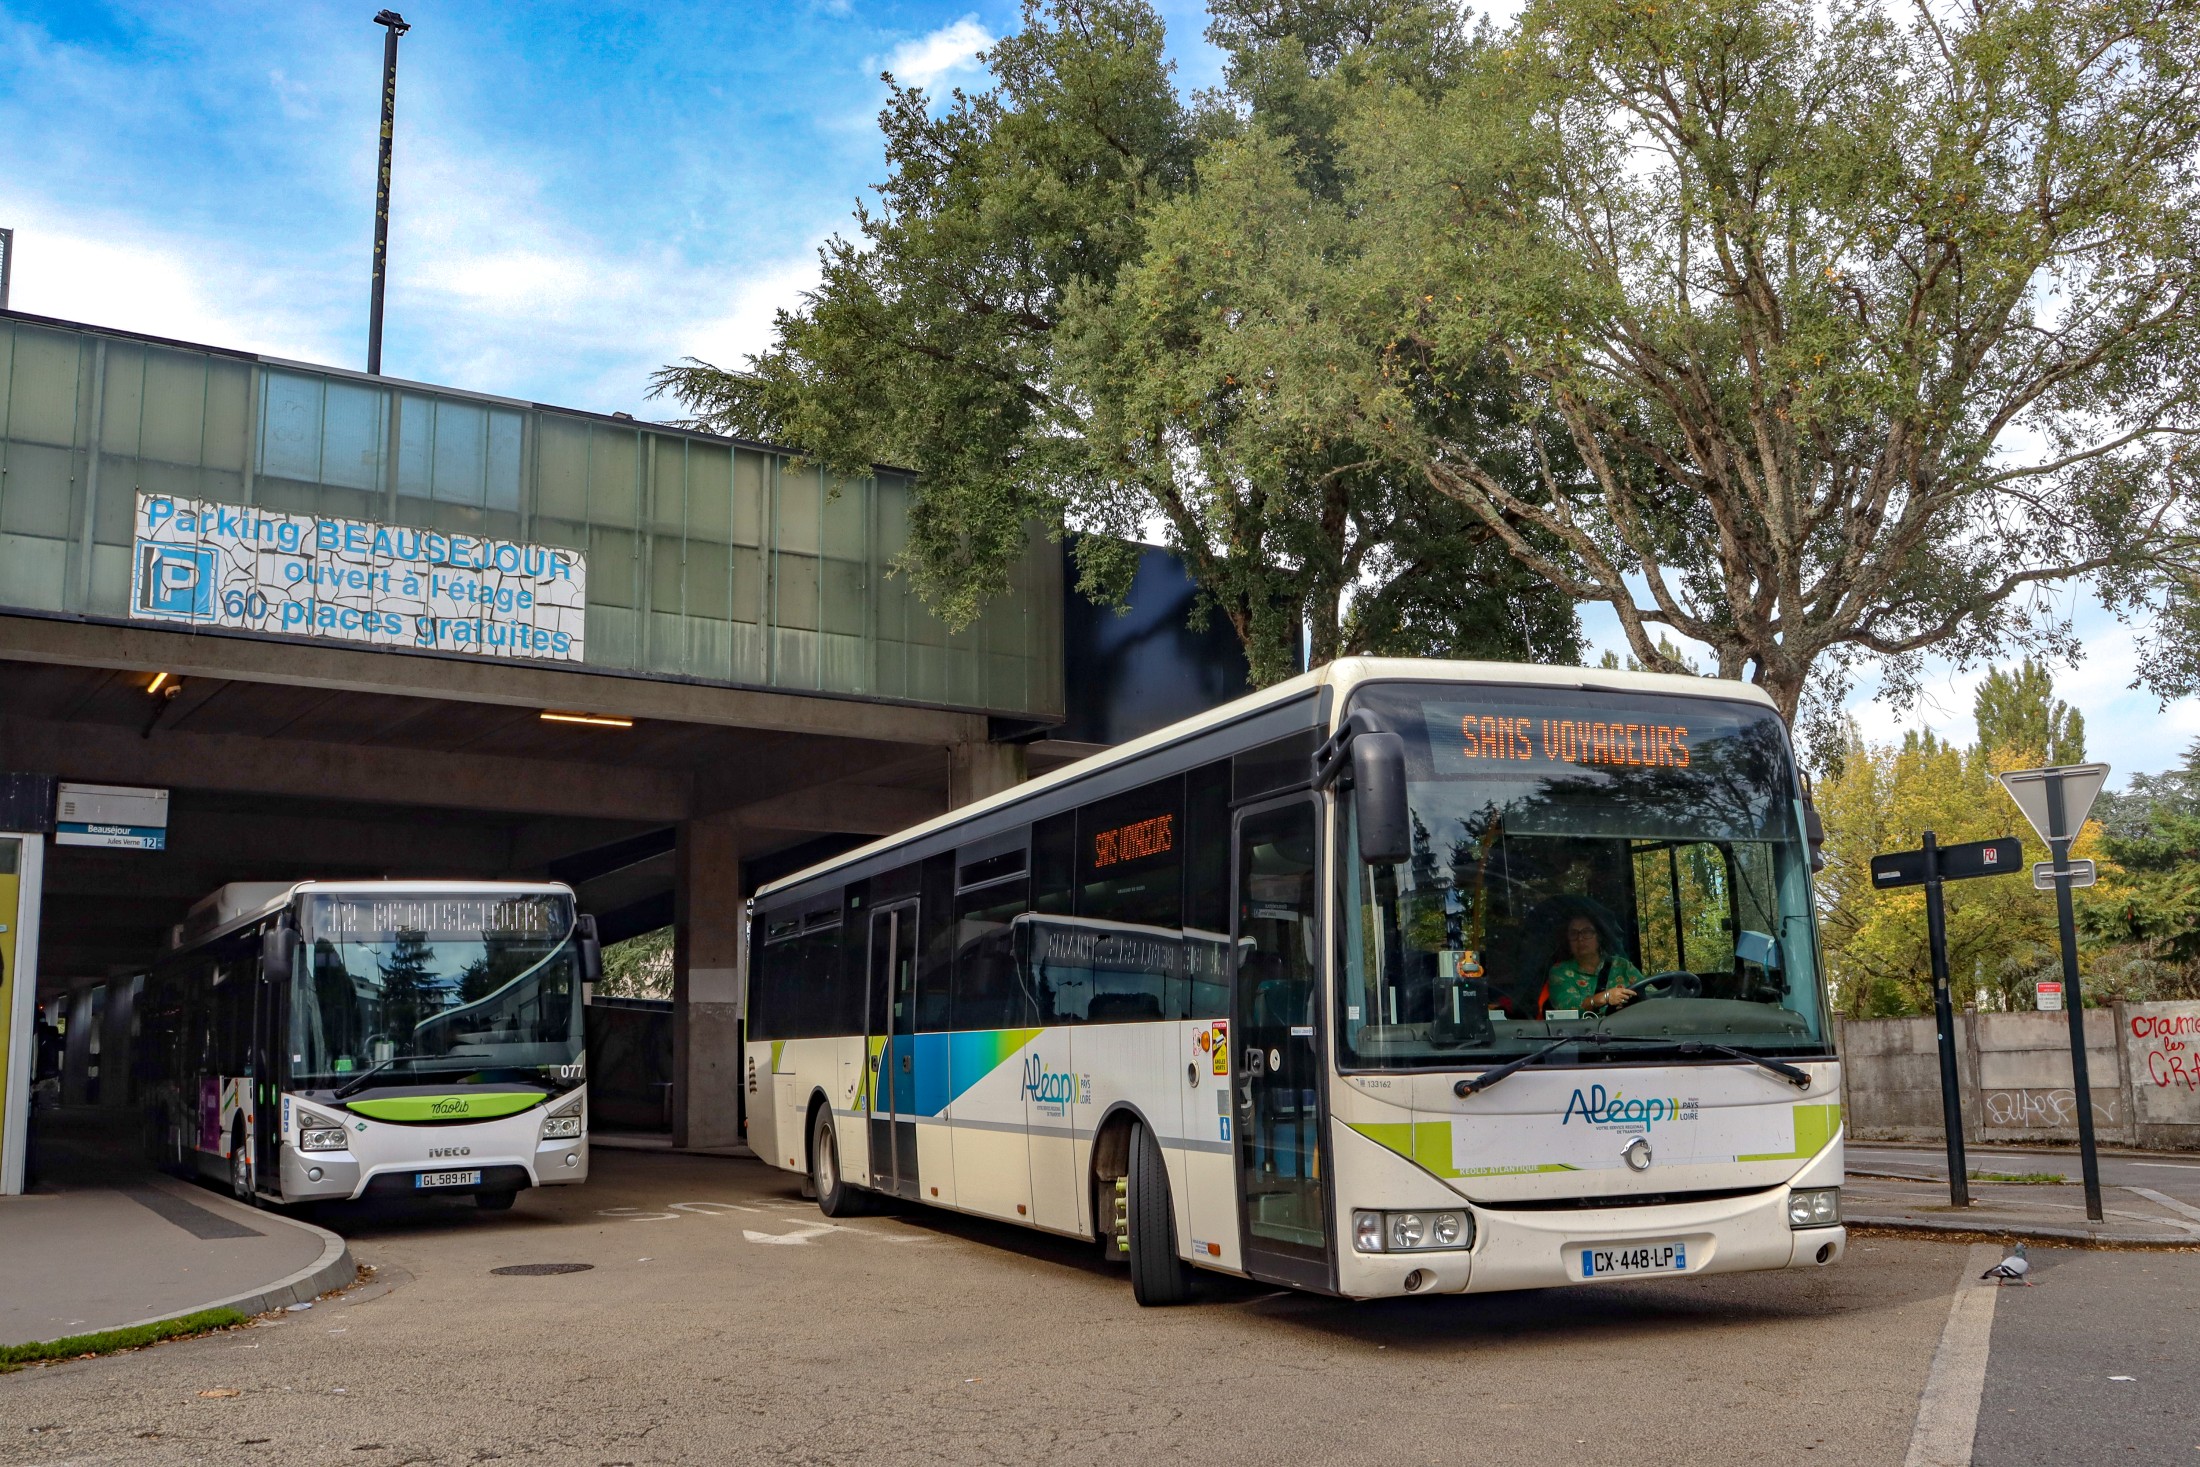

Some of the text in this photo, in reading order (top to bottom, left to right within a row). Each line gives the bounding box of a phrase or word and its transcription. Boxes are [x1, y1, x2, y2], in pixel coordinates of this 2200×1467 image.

[149, 499, 571, 580] Parking BEAUSEJOUR
[284, 562, 533, 613] ouvert à l'étage
[226, 589, 571, 653] 60 places gratuites
[1462, 715, 1690, 768] SANS VOYAGEURS
[87, 824, 131, 836] Beauséjour
[123, 838, 140, 846] Verne
[143, 838, 155, 848] 12
[1095, 814, 1172, 868] SANS VOYAGEURS
[1985, 849, 1995, 861] FO
[2164, 1036, 2185, 1051] les
[560, 1064, 583, 1078] 077
[1081, 1079, 1091, 1089] PAYS
[1367, 1080, 1392, 1088] 133162
[1682, 1101, 1699, 1109] PAYS
[1680, 1112, 1699, 1121] LOIRE
[429, 1146, 471, 1158] IVECO
[1460, 1164, 1539, 1175] KEOLIS ATLANTIQUE
